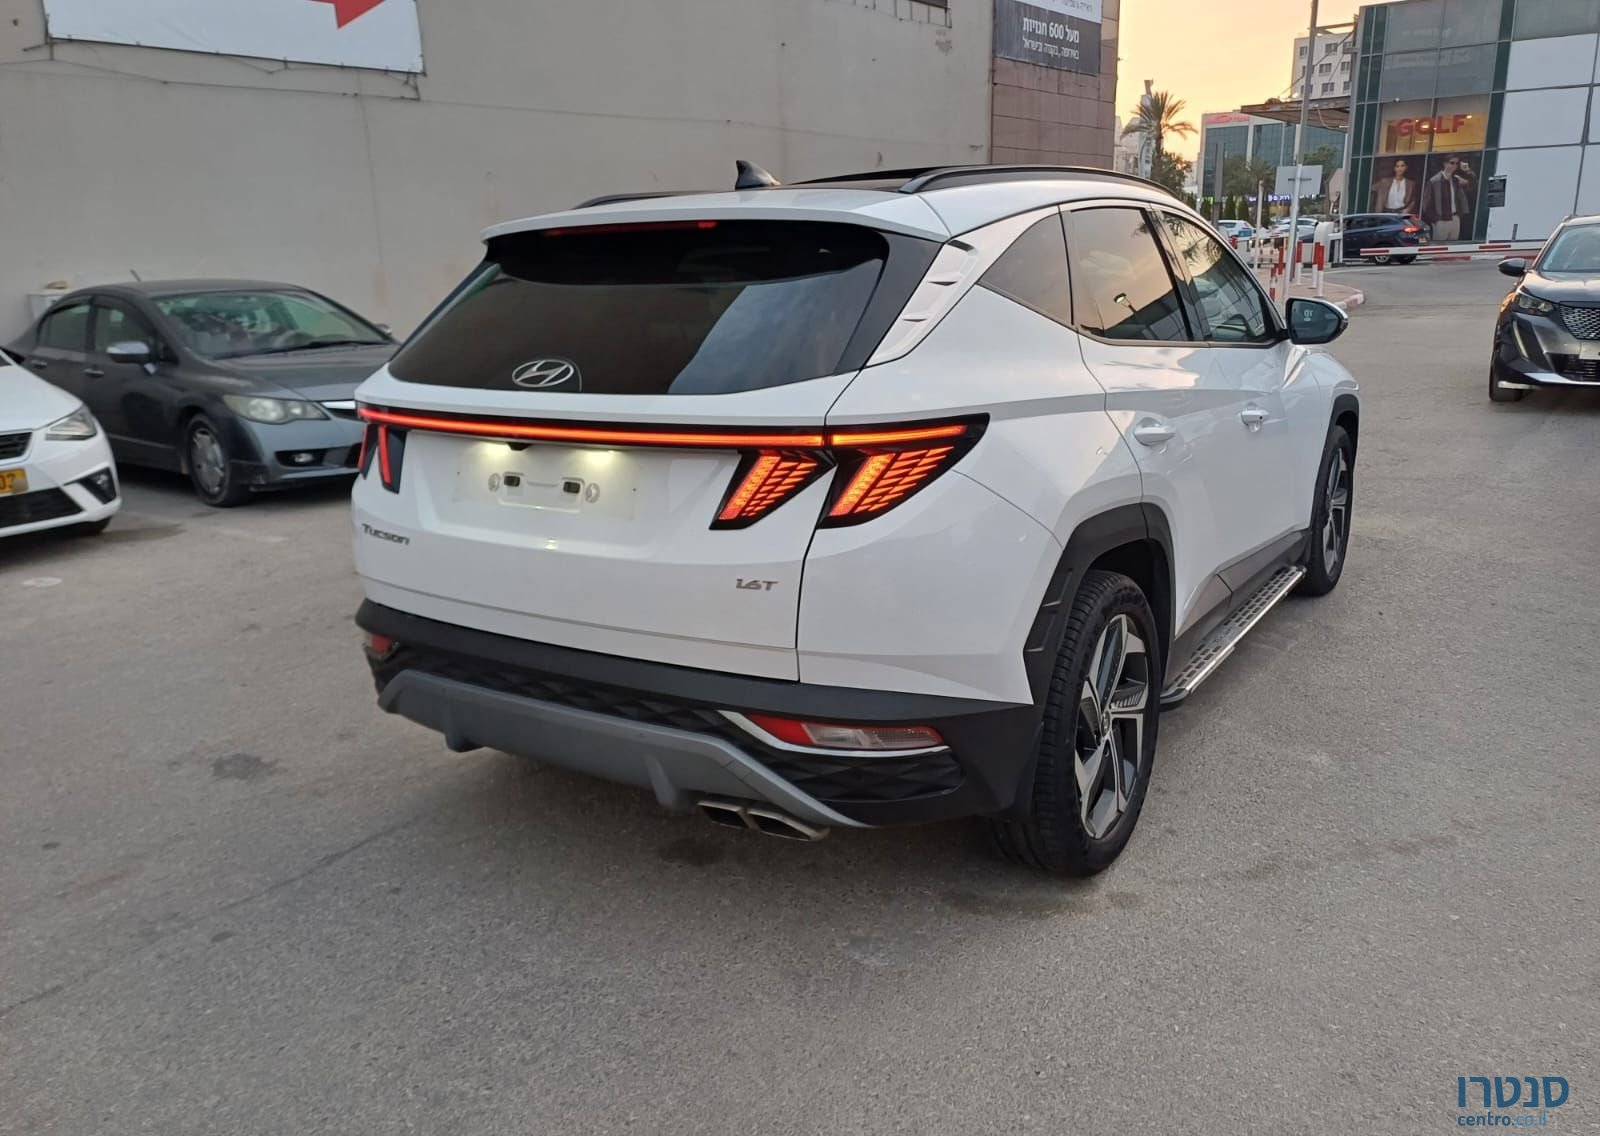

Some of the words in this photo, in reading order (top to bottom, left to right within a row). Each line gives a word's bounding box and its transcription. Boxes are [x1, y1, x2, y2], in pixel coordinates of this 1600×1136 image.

[1048, 22, 1064, 40] 600
[1065, 25, 1080, 44] מעל
[1396, 114, 1468, 137] GOLF
[361, 523, 410, 546] Tucson
